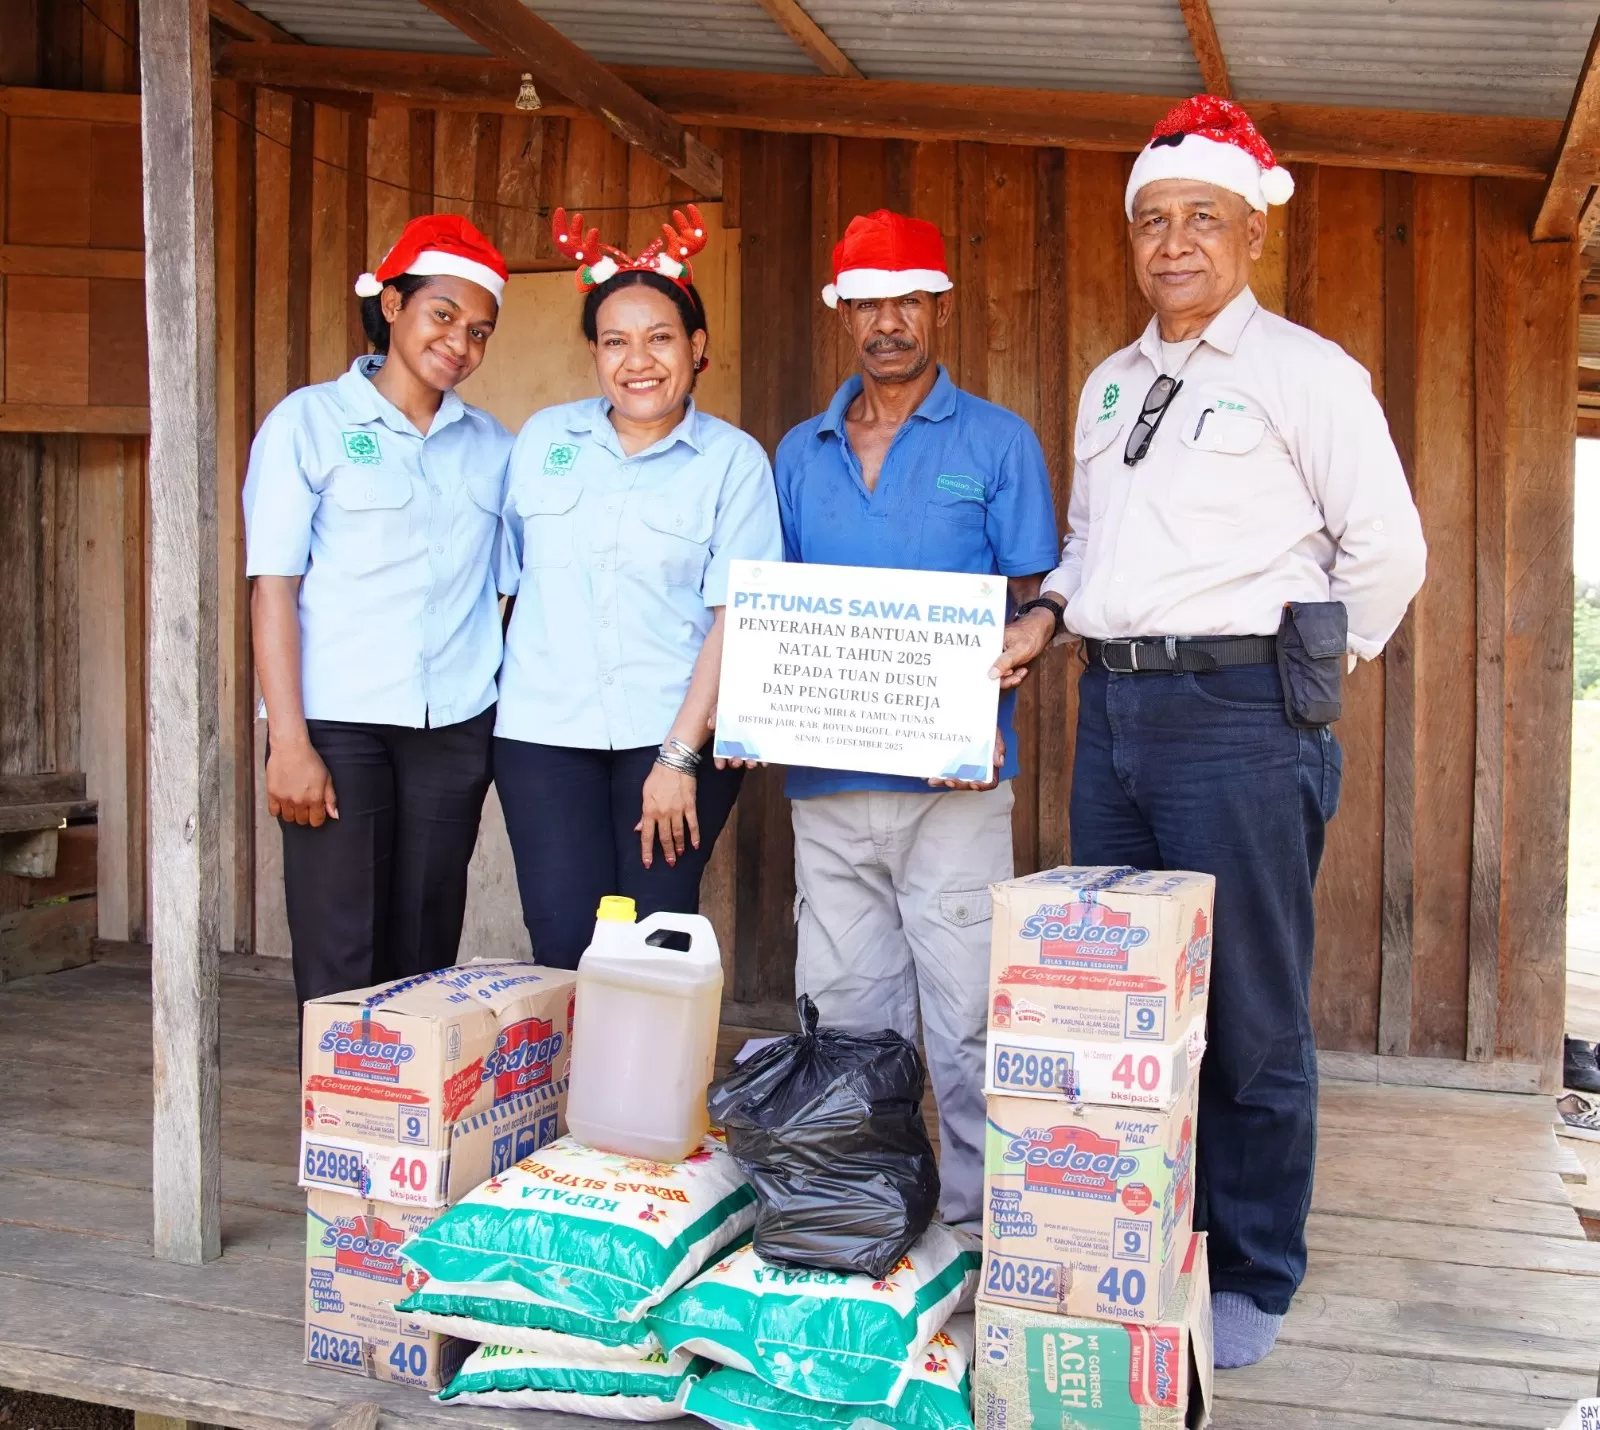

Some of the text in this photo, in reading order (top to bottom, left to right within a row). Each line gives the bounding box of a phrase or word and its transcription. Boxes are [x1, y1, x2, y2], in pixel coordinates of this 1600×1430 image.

[734, 591, 996, 626] PT.TUNAS SAWA ERMA
[739, 617, 982, 647] PENYERAHAN BANTUAN BAMA
[778, 642, 932, 666] NATAL TAHUN 2025
[773, 663, 938, 688] KEPADA TUAN DUSUN
[762, 682, 941, 710] DAN PENGURUS GEREJA
[770, 702, 935, 725] KAMPUNG MIRI & TAMUN TUNAS
[738, 715, 774, 725] DISTRIK
[822, 722, 853, 732] BOVEN
[895, 729, 926, 739] PAPUA
[928, 731, 971, 743] SELATAN
[825, 736, 835, 744] 15
[836, 737, 882, 749] DESEMBER
[884, 742, 903, 751] 2025
[1036, 903, 1067, 918] Mie
[1019, 914, 1150, 951] Sedaap
[1076, 945, 1118, 957] Instant
[1065, 960, 1088, 968] TERASA
[1021, 968, 1077, 984] Goreng
[1108, 979, 1145, 988] Devina
[478, 988, 492, 999] 9
[331, 1020, 354, 1033] Mie
[1086, 1020, 1101, 1028] ALAM
[1136, 1008, 1156, 1031] 9
[318, 1030, 416, 1066] Sedaap
[480, 1031, 564, 1082] Sedaap
[360, 1059, 392, 1070] Instant
[1111, 1054, 1161, 1091] 40
[321, 1078, 362, 1093] Goreng
[384, 1090, 412, 1100] Devina
[1111, 1091, 1160, 1103] bks/packs
[407, 1117, 421, 1137] 9
[1021, 1126, 1053, 1143] Mie
[1115, 1120, 1159, 1134] NIKMAT
[306, 1148, 359, 1183] 62988
[1003, 1138, 1140, 1181] Sedaap
[390, 1156, 428, 1192] 40
[1062, 1172, 1106, 1187] Instant
[521, 1186, 621, 1212] KEPALA
[553, 1174, 690, 1203] BERAS SLYP
[1029, 1185, 1112, 1200] JELAS TERASA SEDAPNYA
[990, 1199, 1018, 1211] AYAM
[334, 1216, 356, 1229] Mie
[994, 1212, 1032, 1223] BAKAR
[1000, 1225, 1037, 1236] LIMAU
[1092, 1243, 1109, 1251] SEGAR
[1123, 1231, 1141, 1253] 9
[362, 1257, 394, 1270] Instant
[310, 1278, 332, 1289] AYAM
[753, 1266, 850, 1286] KEPALA
[988, 1259, 1058, 1298] 20322
[1097, 1267, 1146, 1305] 40
[314, 1289, 341, 1301] BAKAR
[319, 1300, 344, 1312] LIMAU
[1096, 1303, 1145, 1318] bks/packs
[310, 1331, 363, 1366] 20322
[986, 1325, 1009, 1367] 40
[389, 1342, 428, 1377] 40
[1058, 1332, 1088, 1409] ACEH
[1131, 1345, 1141, 1383] Mi Instan
[1087, 1335, 1103, 1409] MI GORENG
